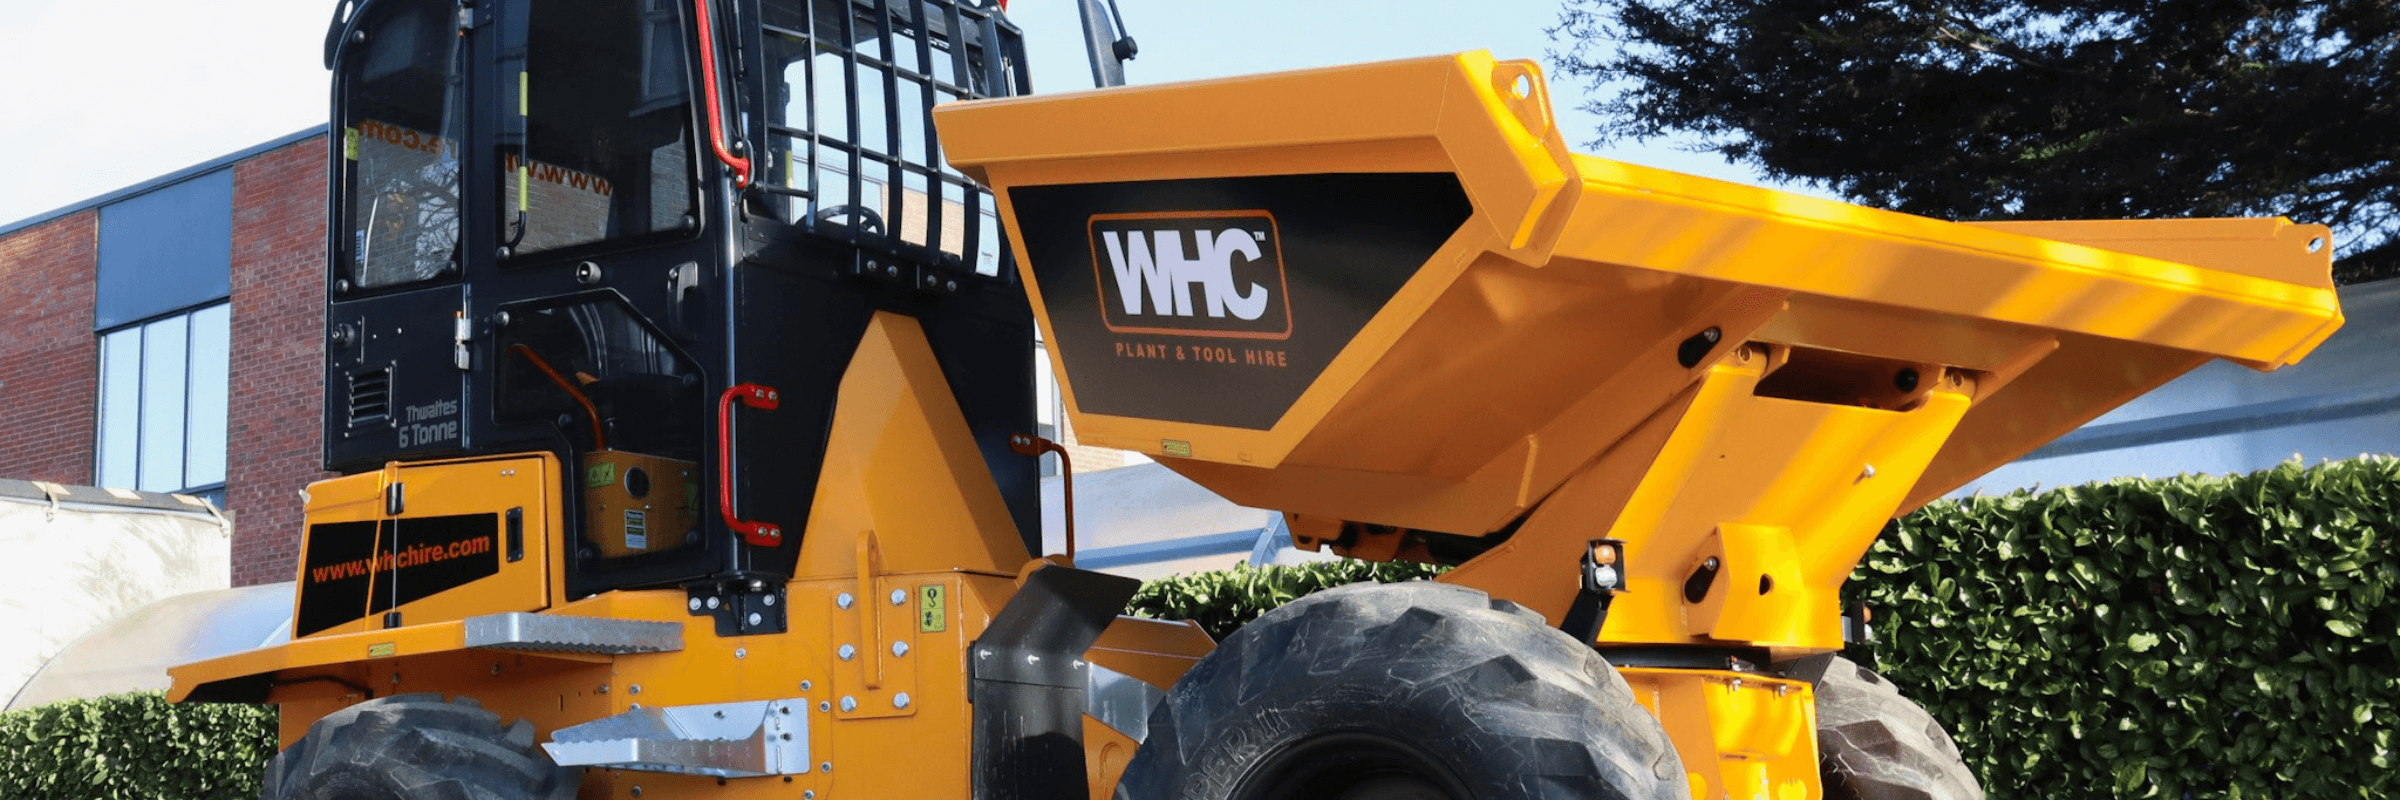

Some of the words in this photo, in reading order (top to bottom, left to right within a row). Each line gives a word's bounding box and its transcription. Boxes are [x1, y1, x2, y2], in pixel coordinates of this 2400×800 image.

[1102, 227, 1269, 321] WHC
[1115, 342, 1167, 360] PLANT
[1175, 346, 1187, 361] &
[1192, 346, 1238, 365] TOOL
[1245, 349, 1288, 368] HIRE
[405, 399, 458, 423] Thwaites
[399, 425, 410, 450] 6
[411, 420, 458, 447] Tonne
[312, 535, 491, 584] www.whchire.com
